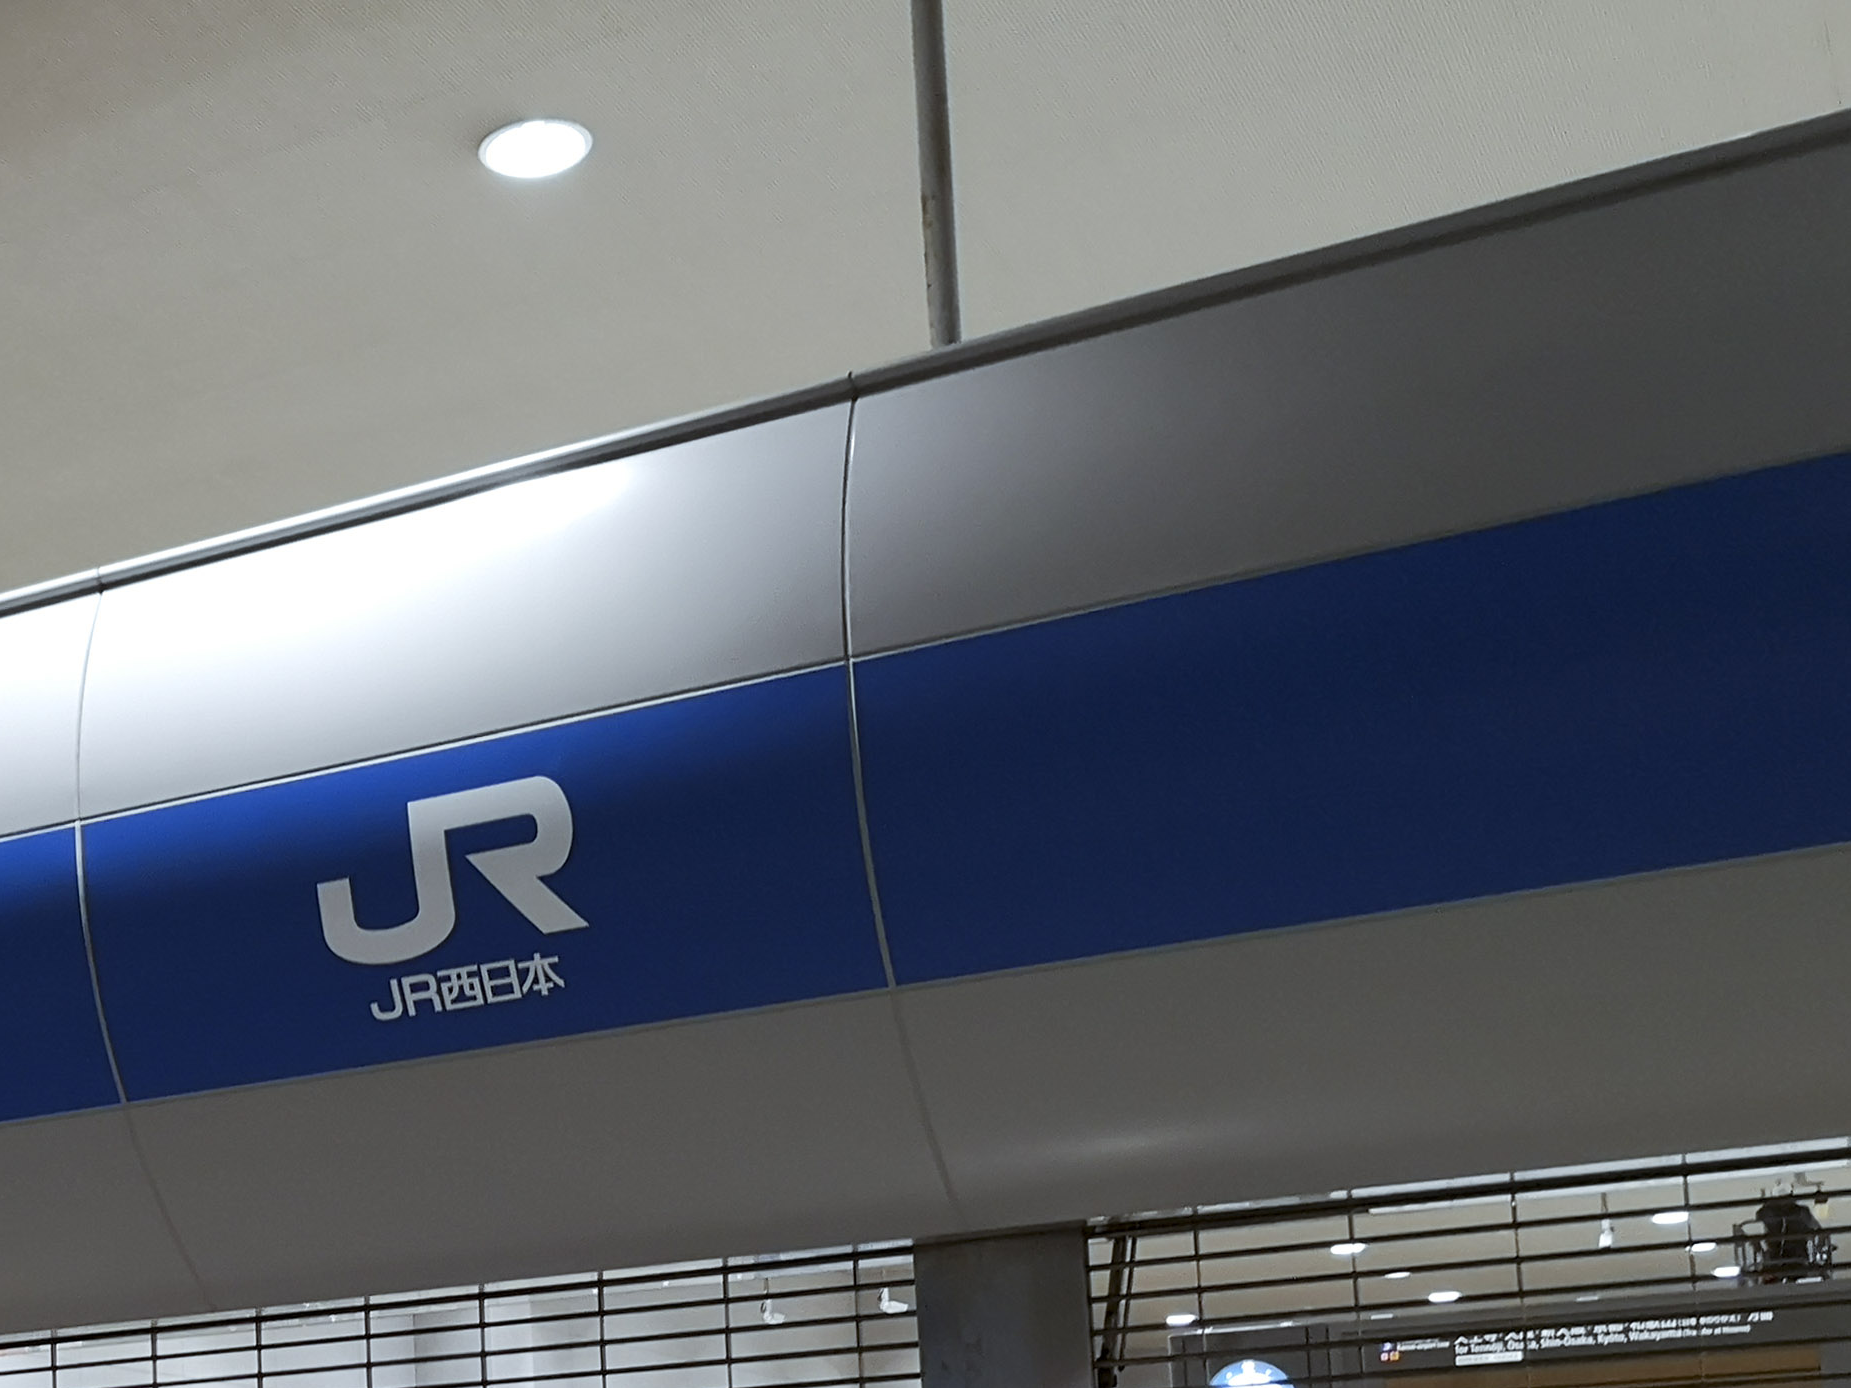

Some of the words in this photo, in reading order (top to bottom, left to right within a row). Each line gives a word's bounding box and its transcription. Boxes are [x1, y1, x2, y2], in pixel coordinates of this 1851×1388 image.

[317, 775, 590, 965] JR
[370, 953, 565, 1021] JR西日本
